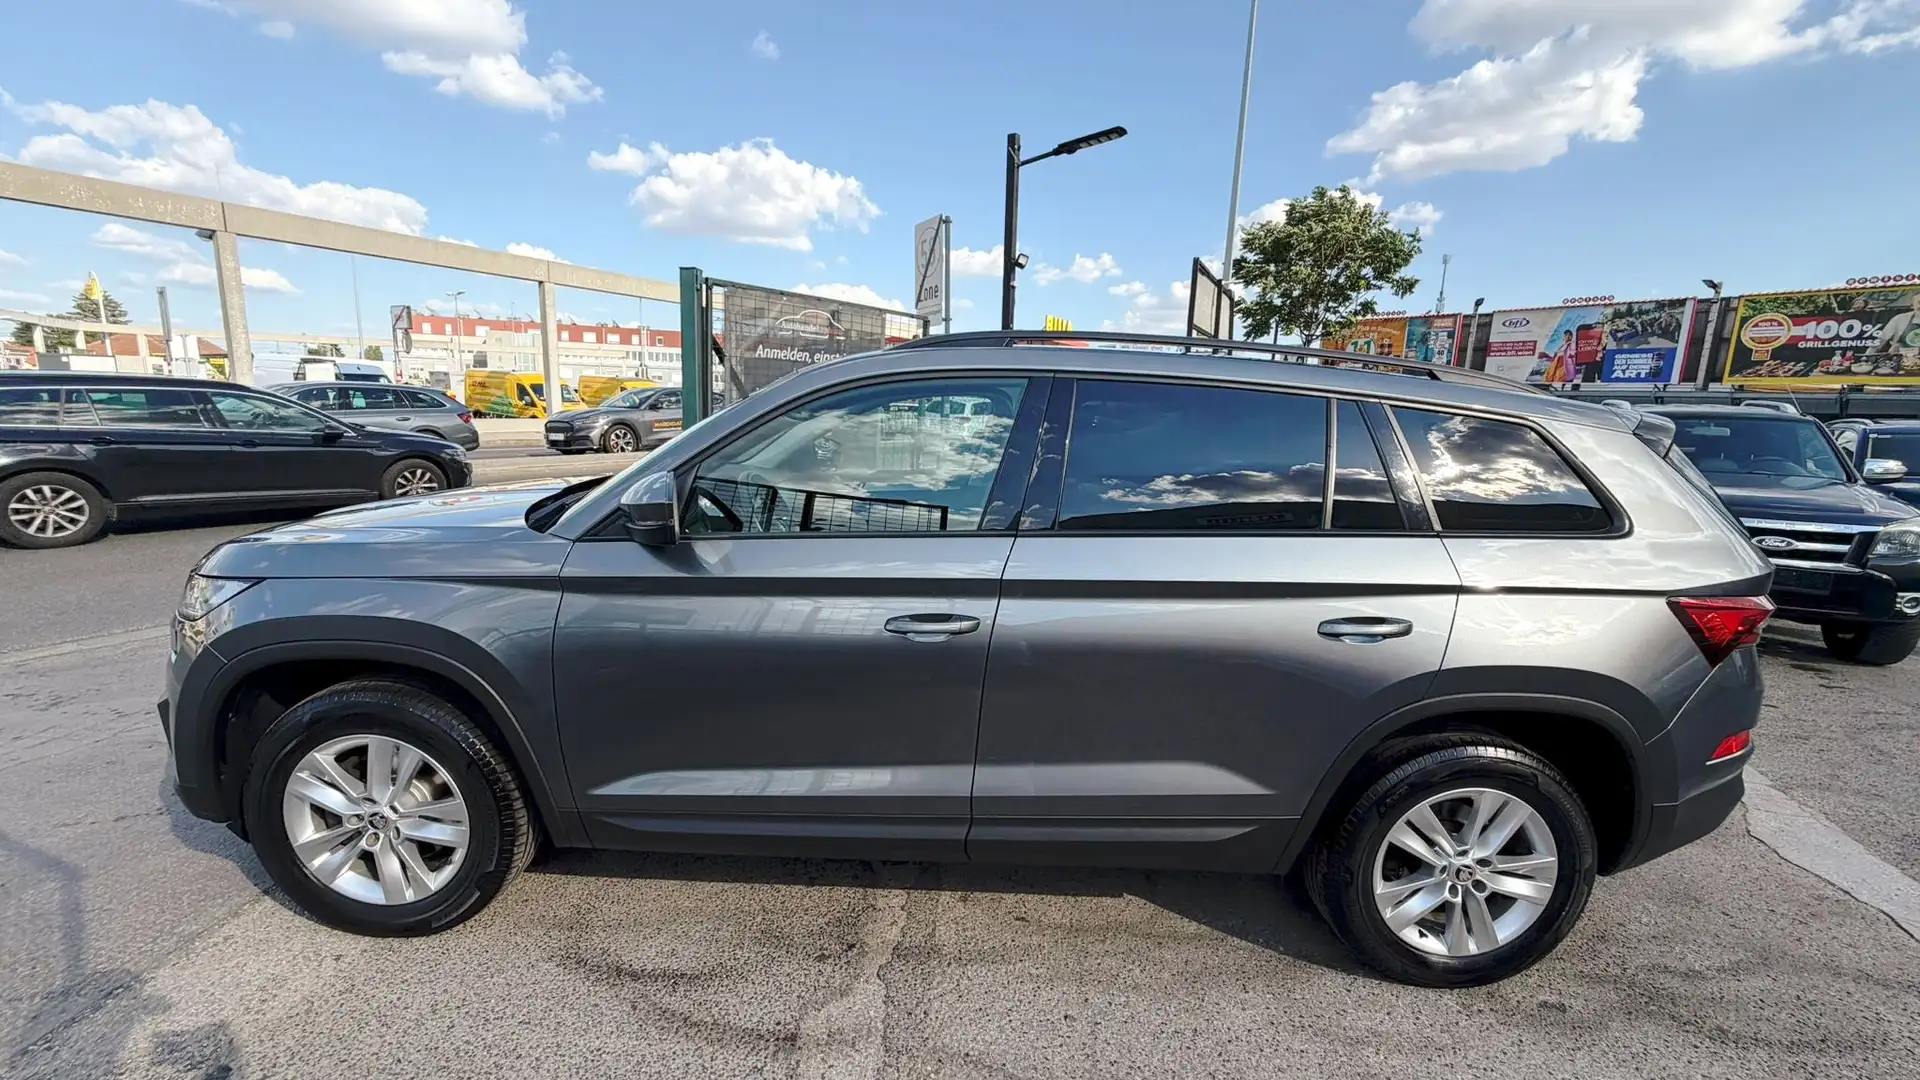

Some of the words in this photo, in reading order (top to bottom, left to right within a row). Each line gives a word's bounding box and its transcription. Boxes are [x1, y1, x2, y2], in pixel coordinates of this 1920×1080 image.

[780, 321, 820, 332] Autohandel
[1804, 319, 1883, 339] 100%
[1797, 339, 1881, 348] GRILLGENUSS
[755, 344, 811, 363] Anmelden,
[1610, 370, 1650, 379] ART
[1762, 539, 1787, 547] Ford
